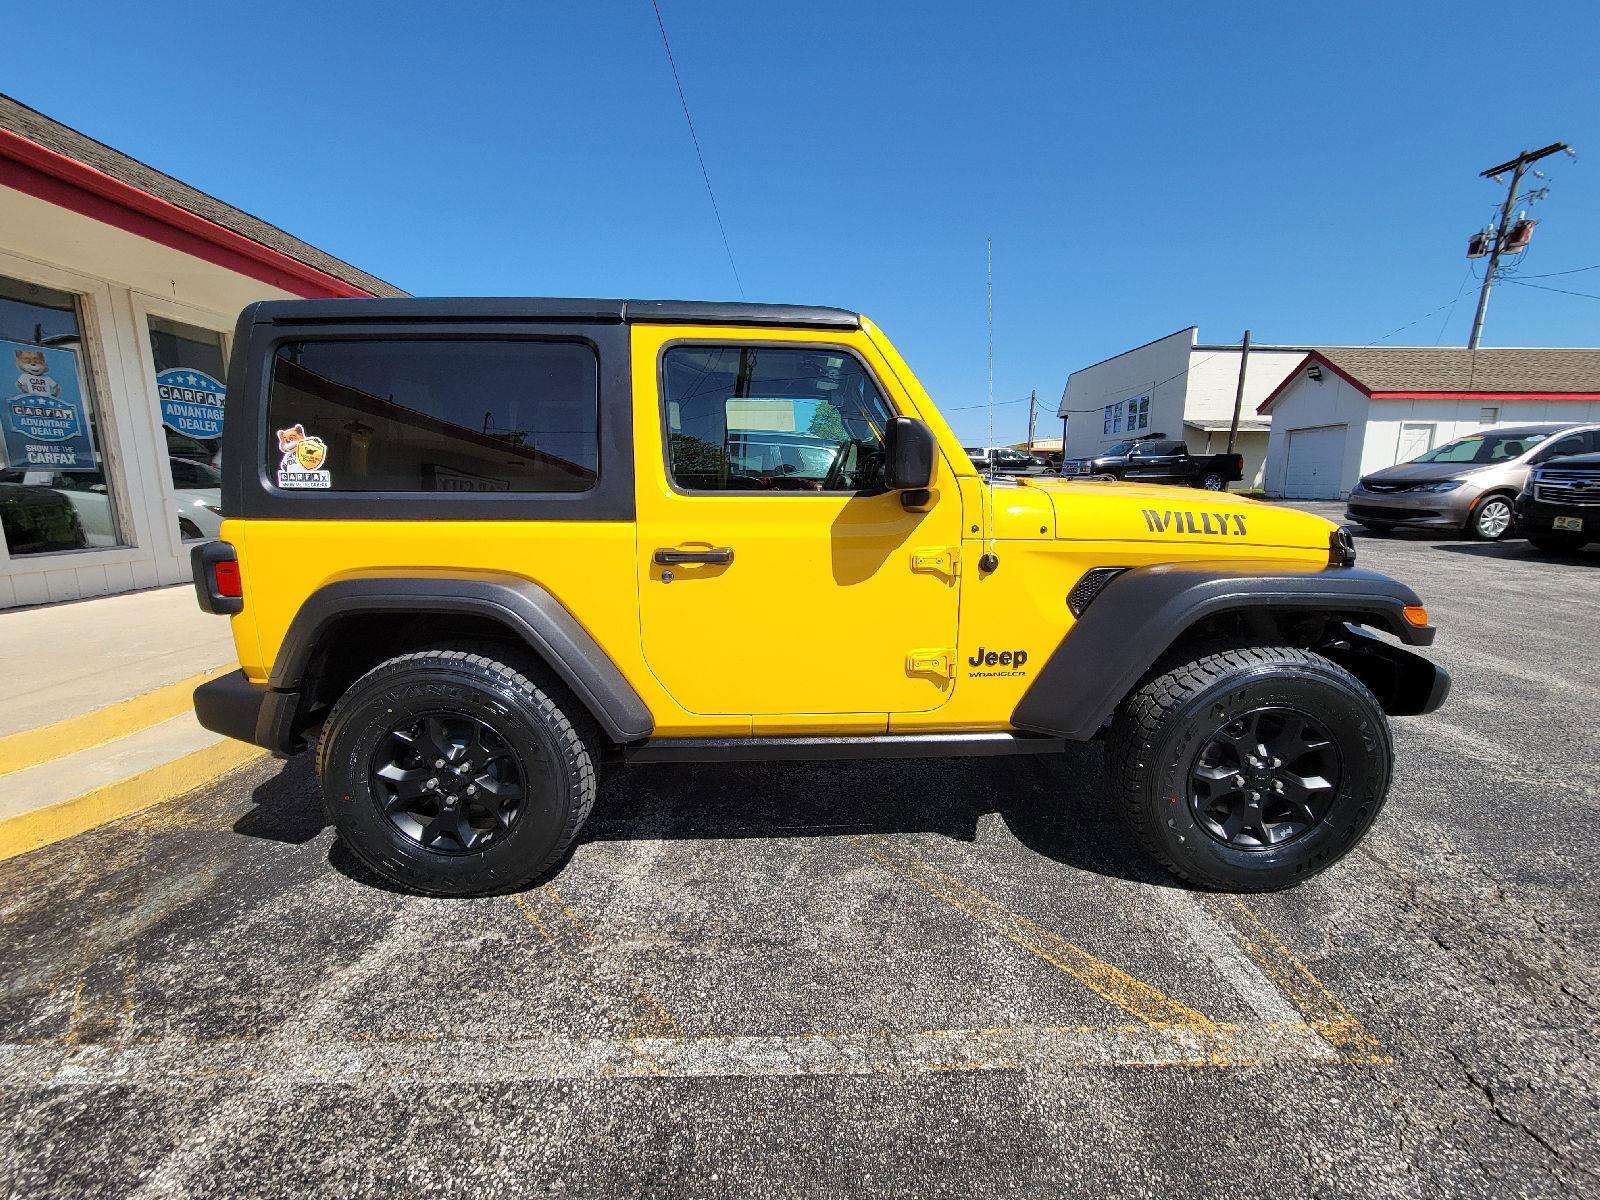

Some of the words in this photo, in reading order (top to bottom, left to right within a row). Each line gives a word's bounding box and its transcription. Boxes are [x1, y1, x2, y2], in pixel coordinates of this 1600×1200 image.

[29, 378, 46, 386] CAR
[32, 385, 47, 393] FOX
[158, 386, 226, 407] CARFAX
[13, 406, 73, 419] CARFAX
[166, 403, 225, 420] ADVANTAGE
[20, 417, 71, 429] ADVANTAGE
[178, 417, 218, 431] DEALER
[31, 427, 65, 436] DEALER
[25, 444, 49, 453] SHOW
[27, 452, 77, 464] CARFAX
[281, 473, 327, 482] CARFAX
[1141, 509, 1247, 536] WILLYS
[968, 646, 1028, 669] Jeep
